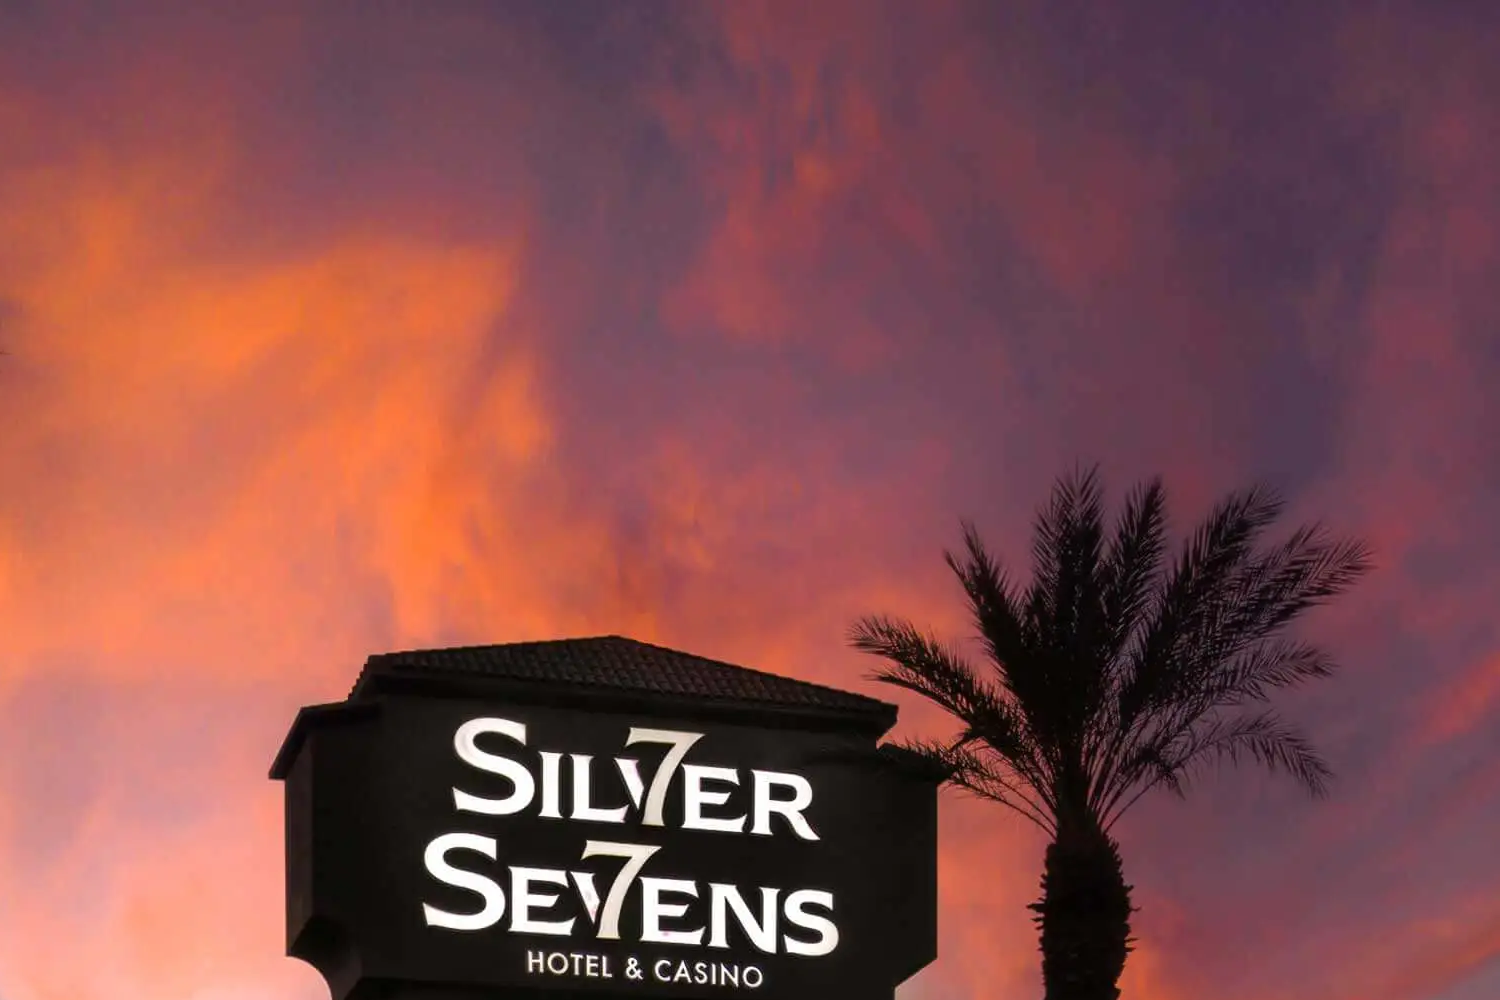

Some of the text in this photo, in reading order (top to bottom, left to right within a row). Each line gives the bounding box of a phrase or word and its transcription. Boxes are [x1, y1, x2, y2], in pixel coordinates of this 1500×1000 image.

[527, 950, 763, 988] HOTEL & CASINO
